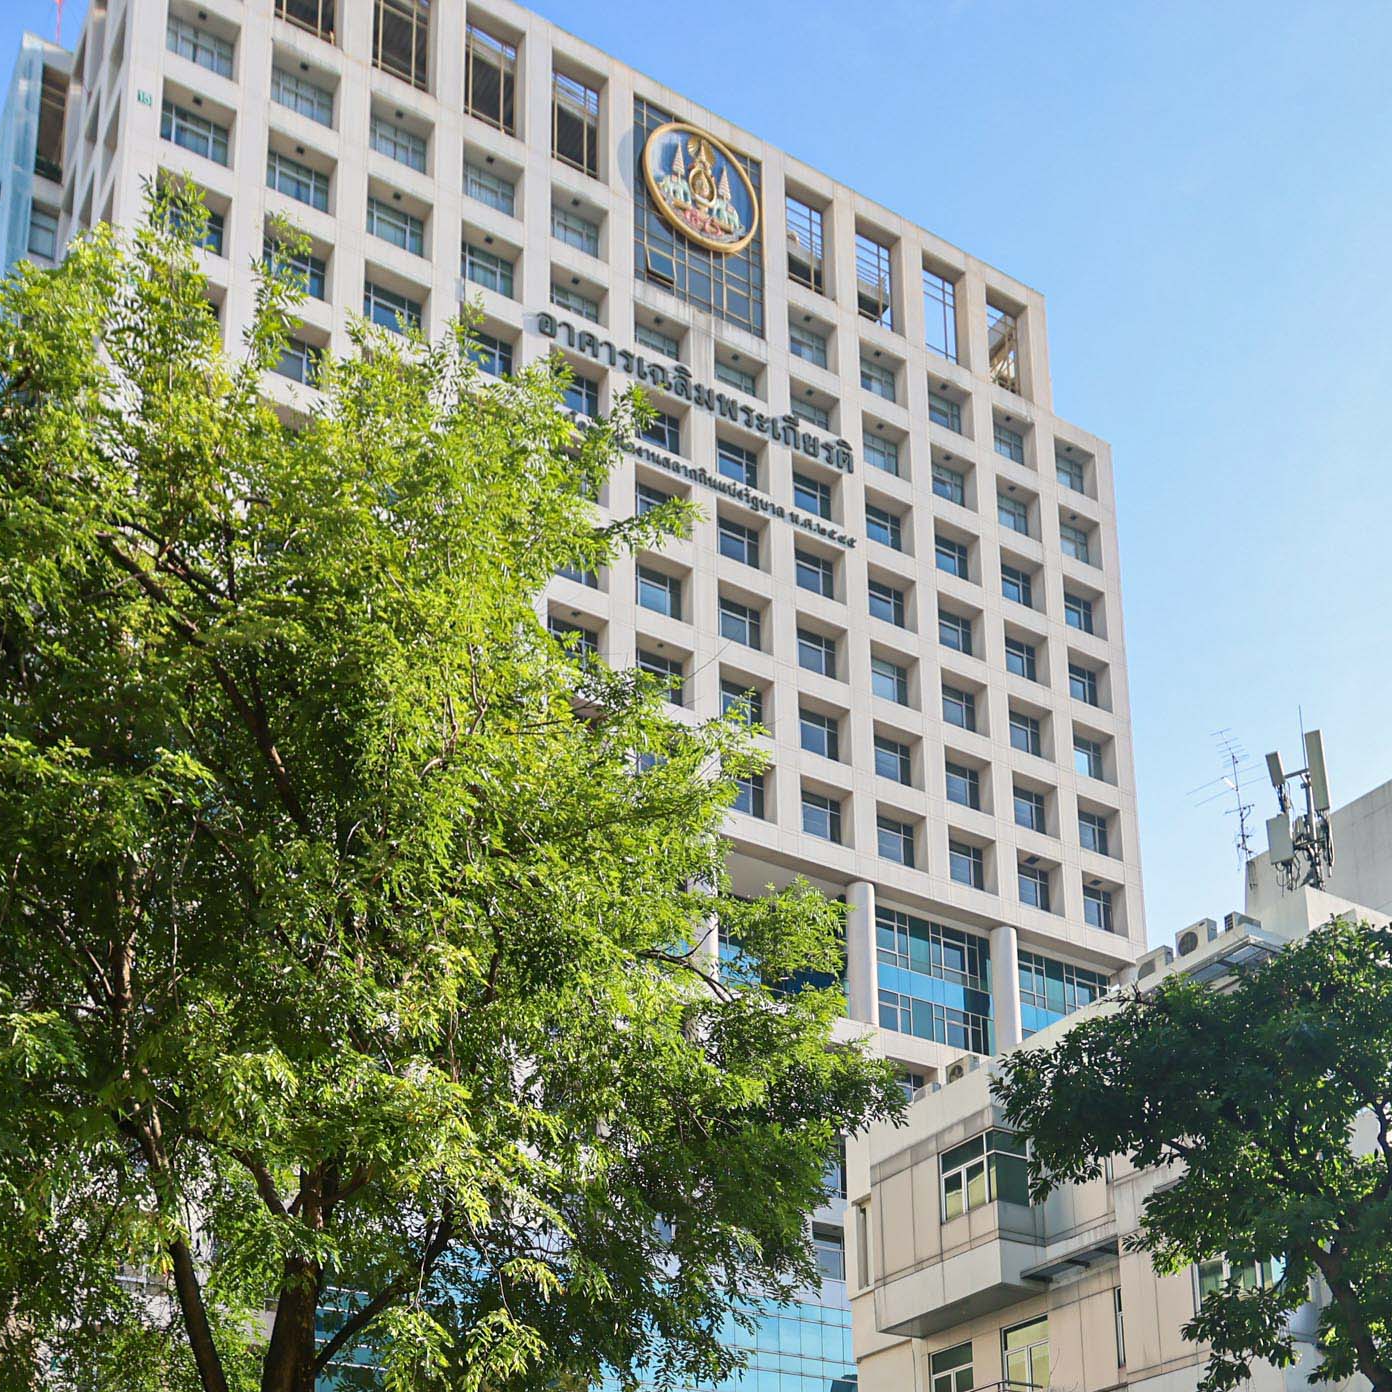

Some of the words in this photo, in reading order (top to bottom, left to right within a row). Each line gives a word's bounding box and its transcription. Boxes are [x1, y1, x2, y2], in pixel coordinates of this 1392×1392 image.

[536, 311, 854, 474] อาคารเฉลิมพระเกียรติ
